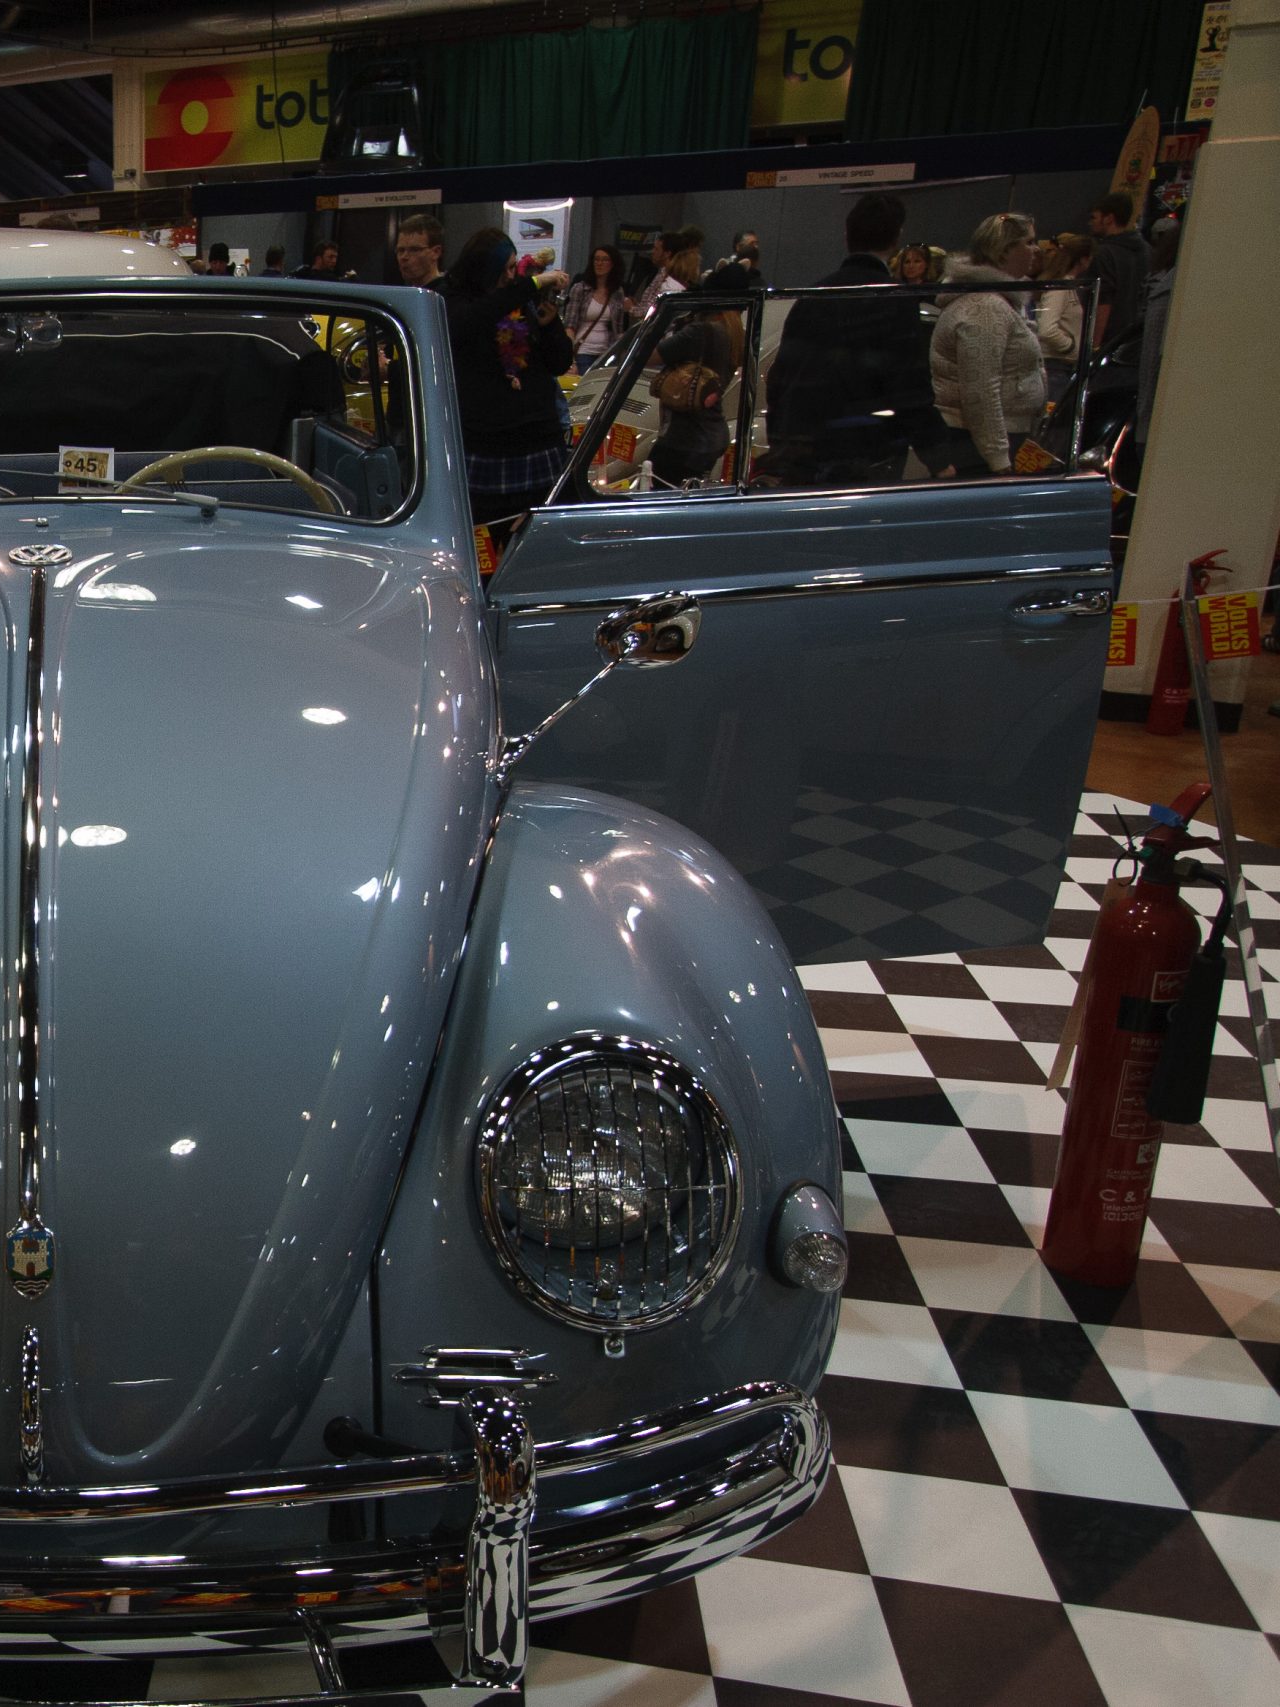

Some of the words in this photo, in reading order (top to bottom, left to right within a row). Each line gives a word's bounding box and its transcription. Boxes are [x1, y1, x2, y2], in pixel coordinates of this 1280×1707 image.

[817, 171, 849, 180] VINTAGE
[850, 169, 874, 178] SPEED
[74, 457, 97, 473] 45
[1109, 606, 1128, 660] VOLKS
[1208, 597, 1230, 653] WORLD
[1228, 595, 1250, 651] VOLKS
